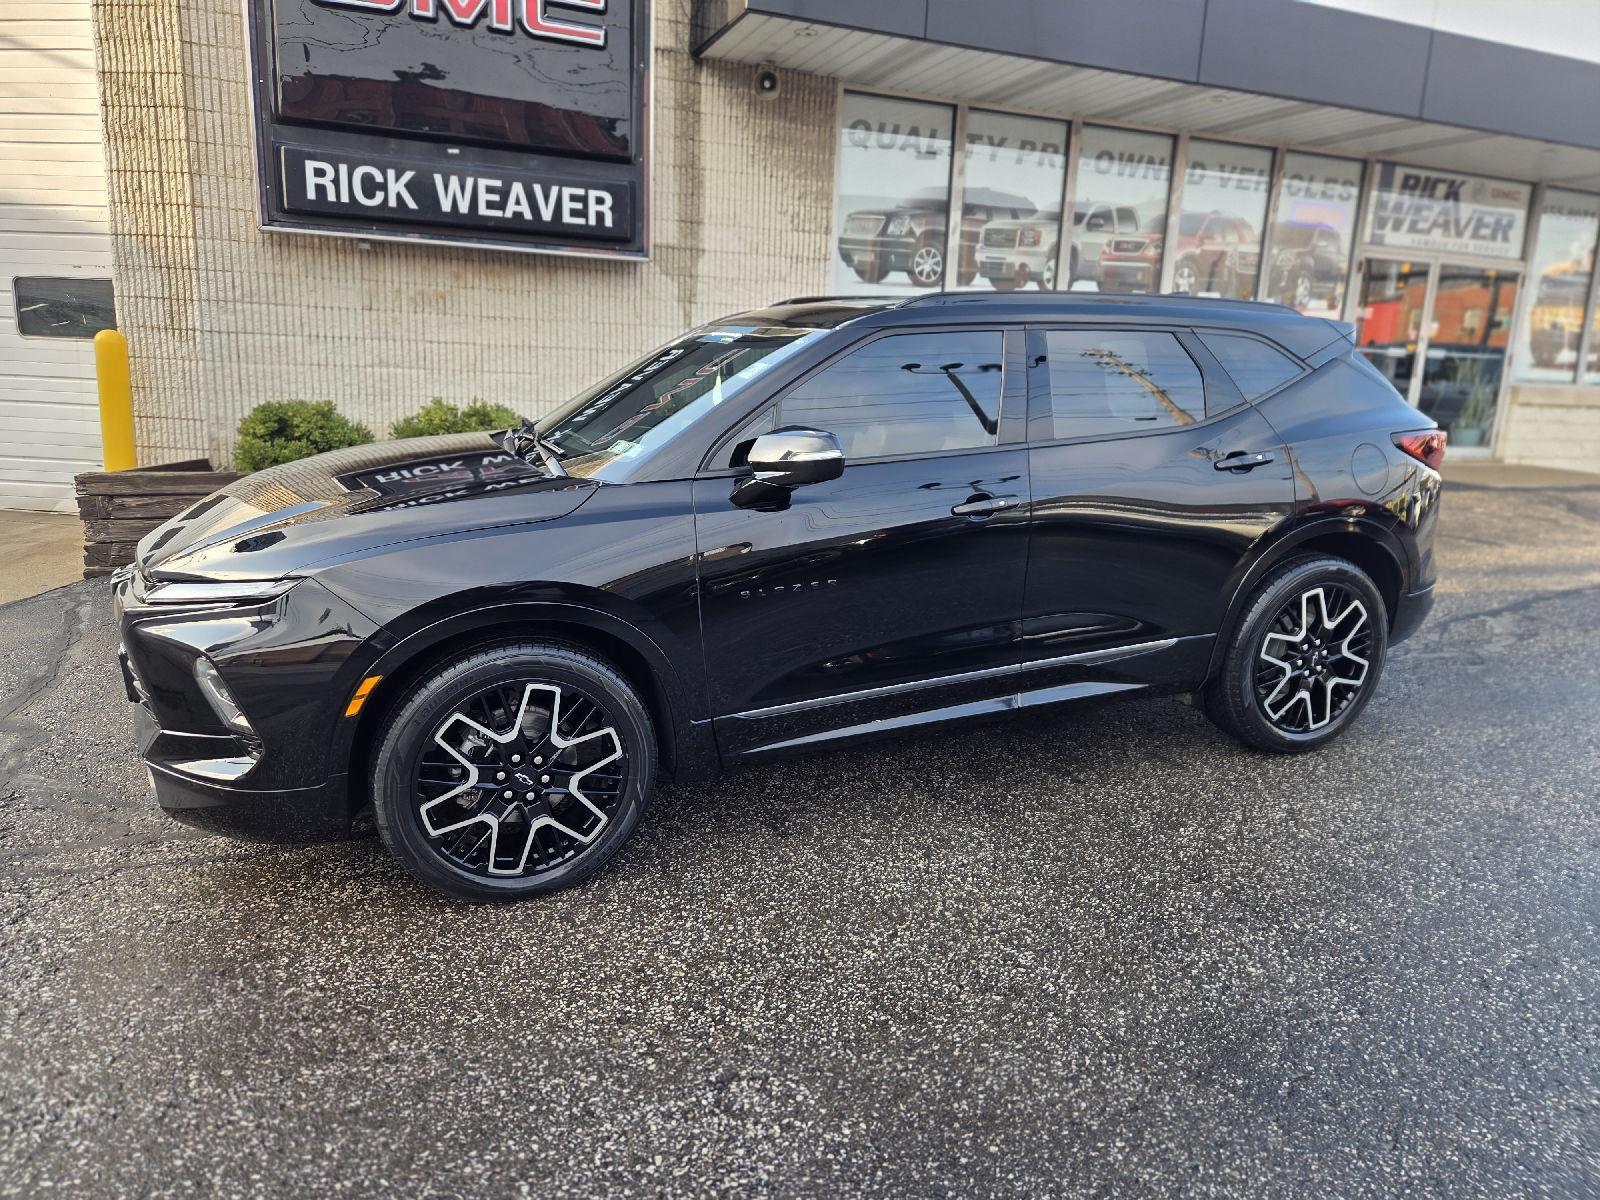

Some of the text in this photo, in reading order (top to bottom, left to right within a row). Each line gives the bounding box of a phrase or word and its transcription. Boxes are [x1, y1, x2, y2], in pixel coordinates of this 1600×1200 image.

[848, 119, 1008, 162] QUALTY
[1219, 163, 1355, 201] VEHCLES
[304, 159, 613, 228] RICK WEAVER
[1400, 174, 1467, 203] RICK
[1375, 199, 1516, 243] WEAVER
